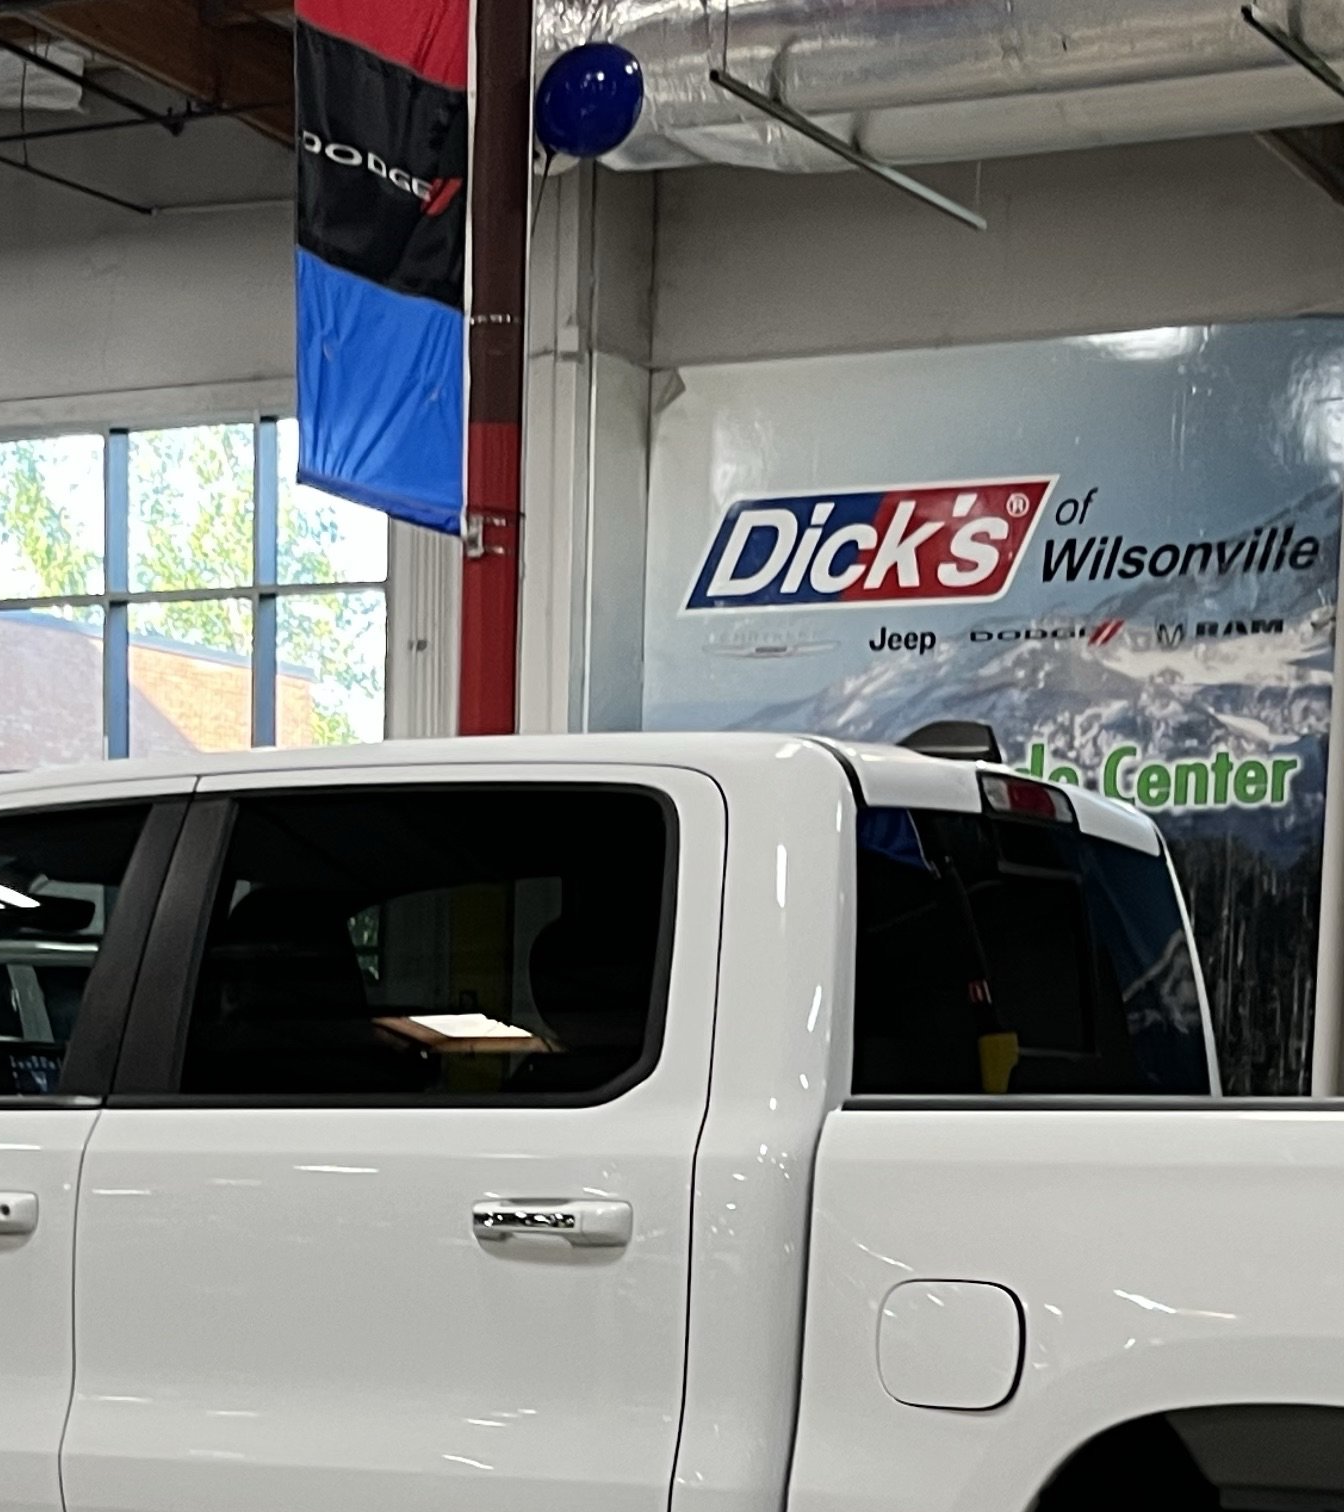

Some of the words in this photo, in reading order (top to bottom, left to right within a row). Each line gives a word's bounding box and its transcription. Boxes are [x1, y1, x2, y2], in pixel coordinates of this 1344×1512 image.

[303, 130, 433, 201] DODGE
[1056, 487, 1099, 526] of
[706, 493, 1010, 598] Dick's
[1042, 523, 1319, 582] Wilsonville
[869, 626, 936, 655] Jeep
[1196, 619, 1284, 637] RAM
[1103, 746, 1298, 808] Center
